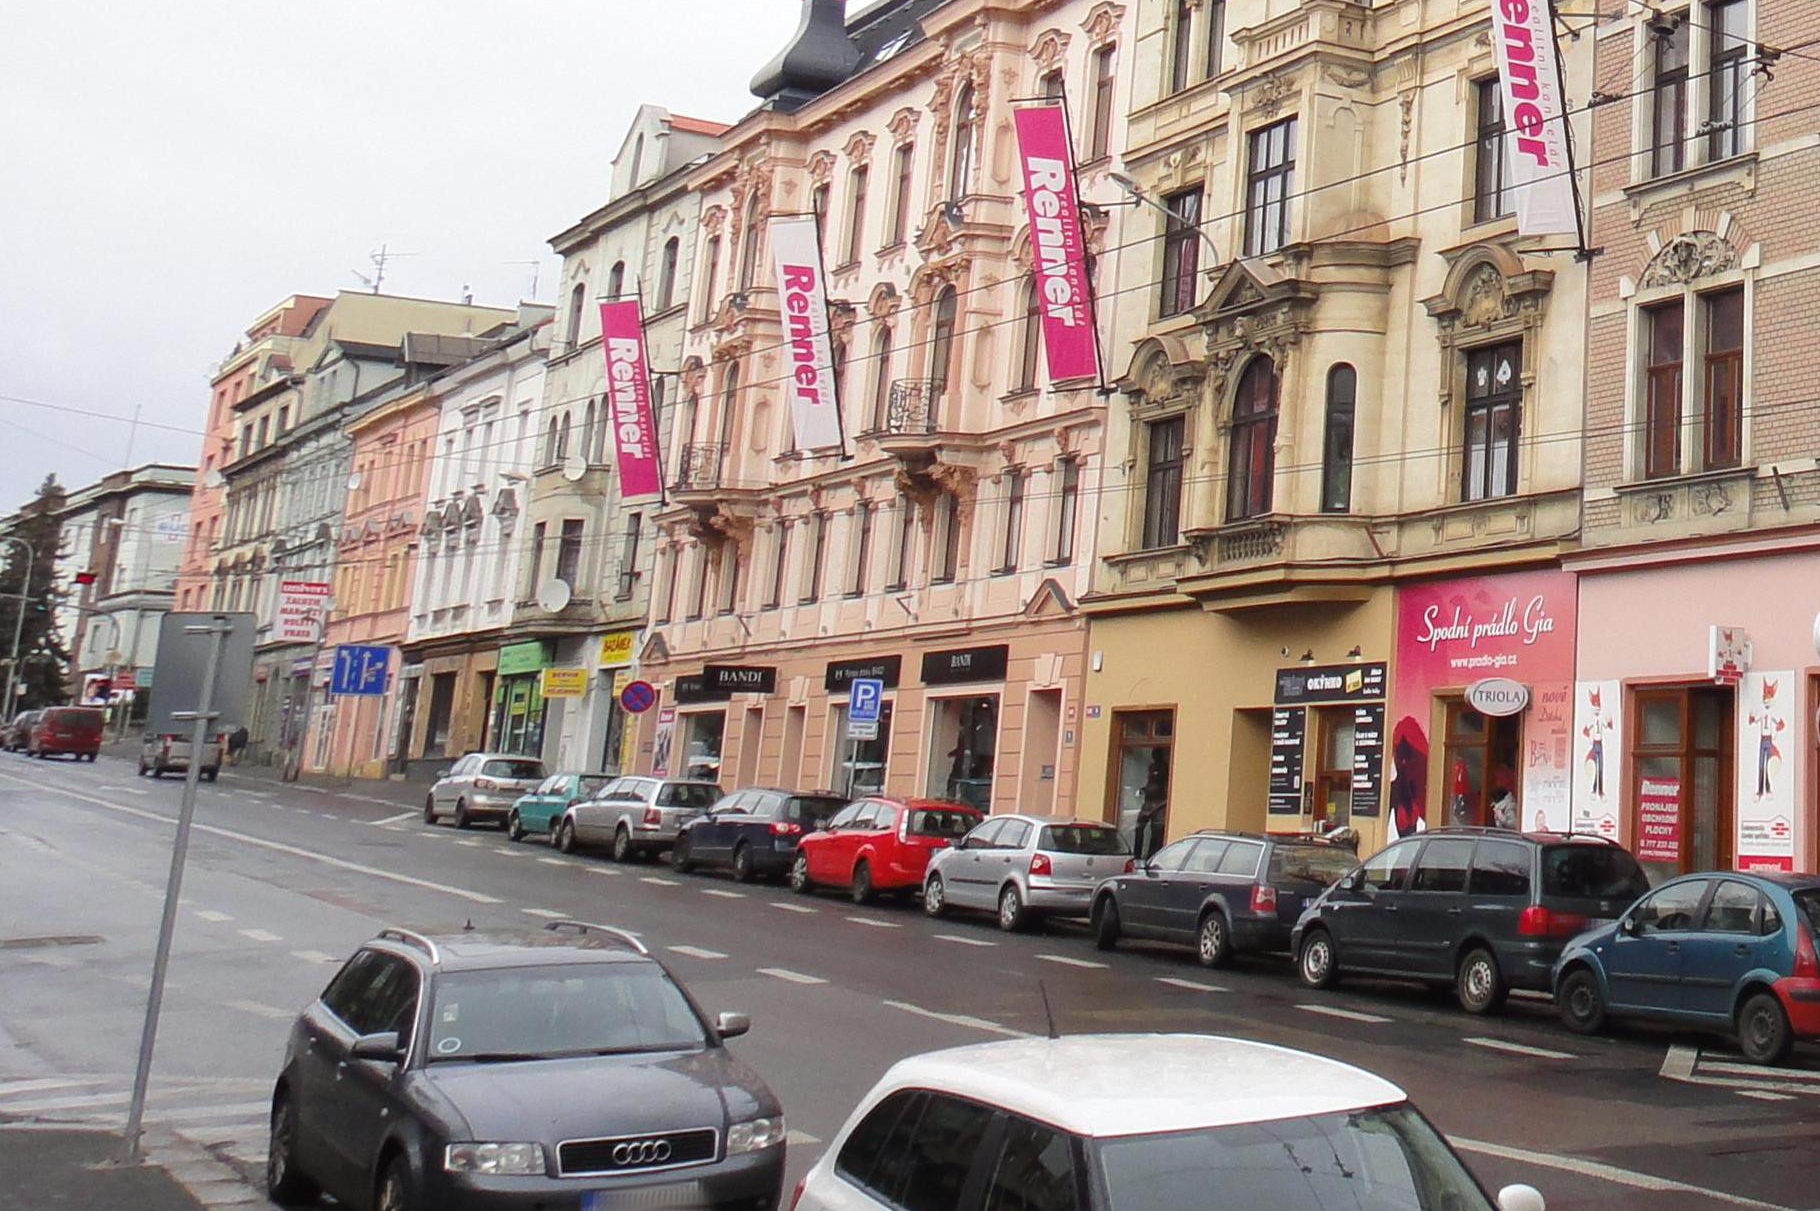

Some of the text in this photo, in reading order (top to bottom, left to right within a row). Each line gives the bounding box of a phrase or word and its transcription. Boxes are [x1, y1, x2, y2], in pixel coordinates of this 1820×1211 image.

[1027, 156, 1076, 327] Renner
[783, 264, 821, 405] Renner
[608, 338, 644, 459] Renner
[1417, 595, 1553, 651] Spodní prádlo Gia
[719, 670, 763, 682] BANDI
[857, 685, 874, 708] P
[1479, 691, 1521, 703] TRIOLA
